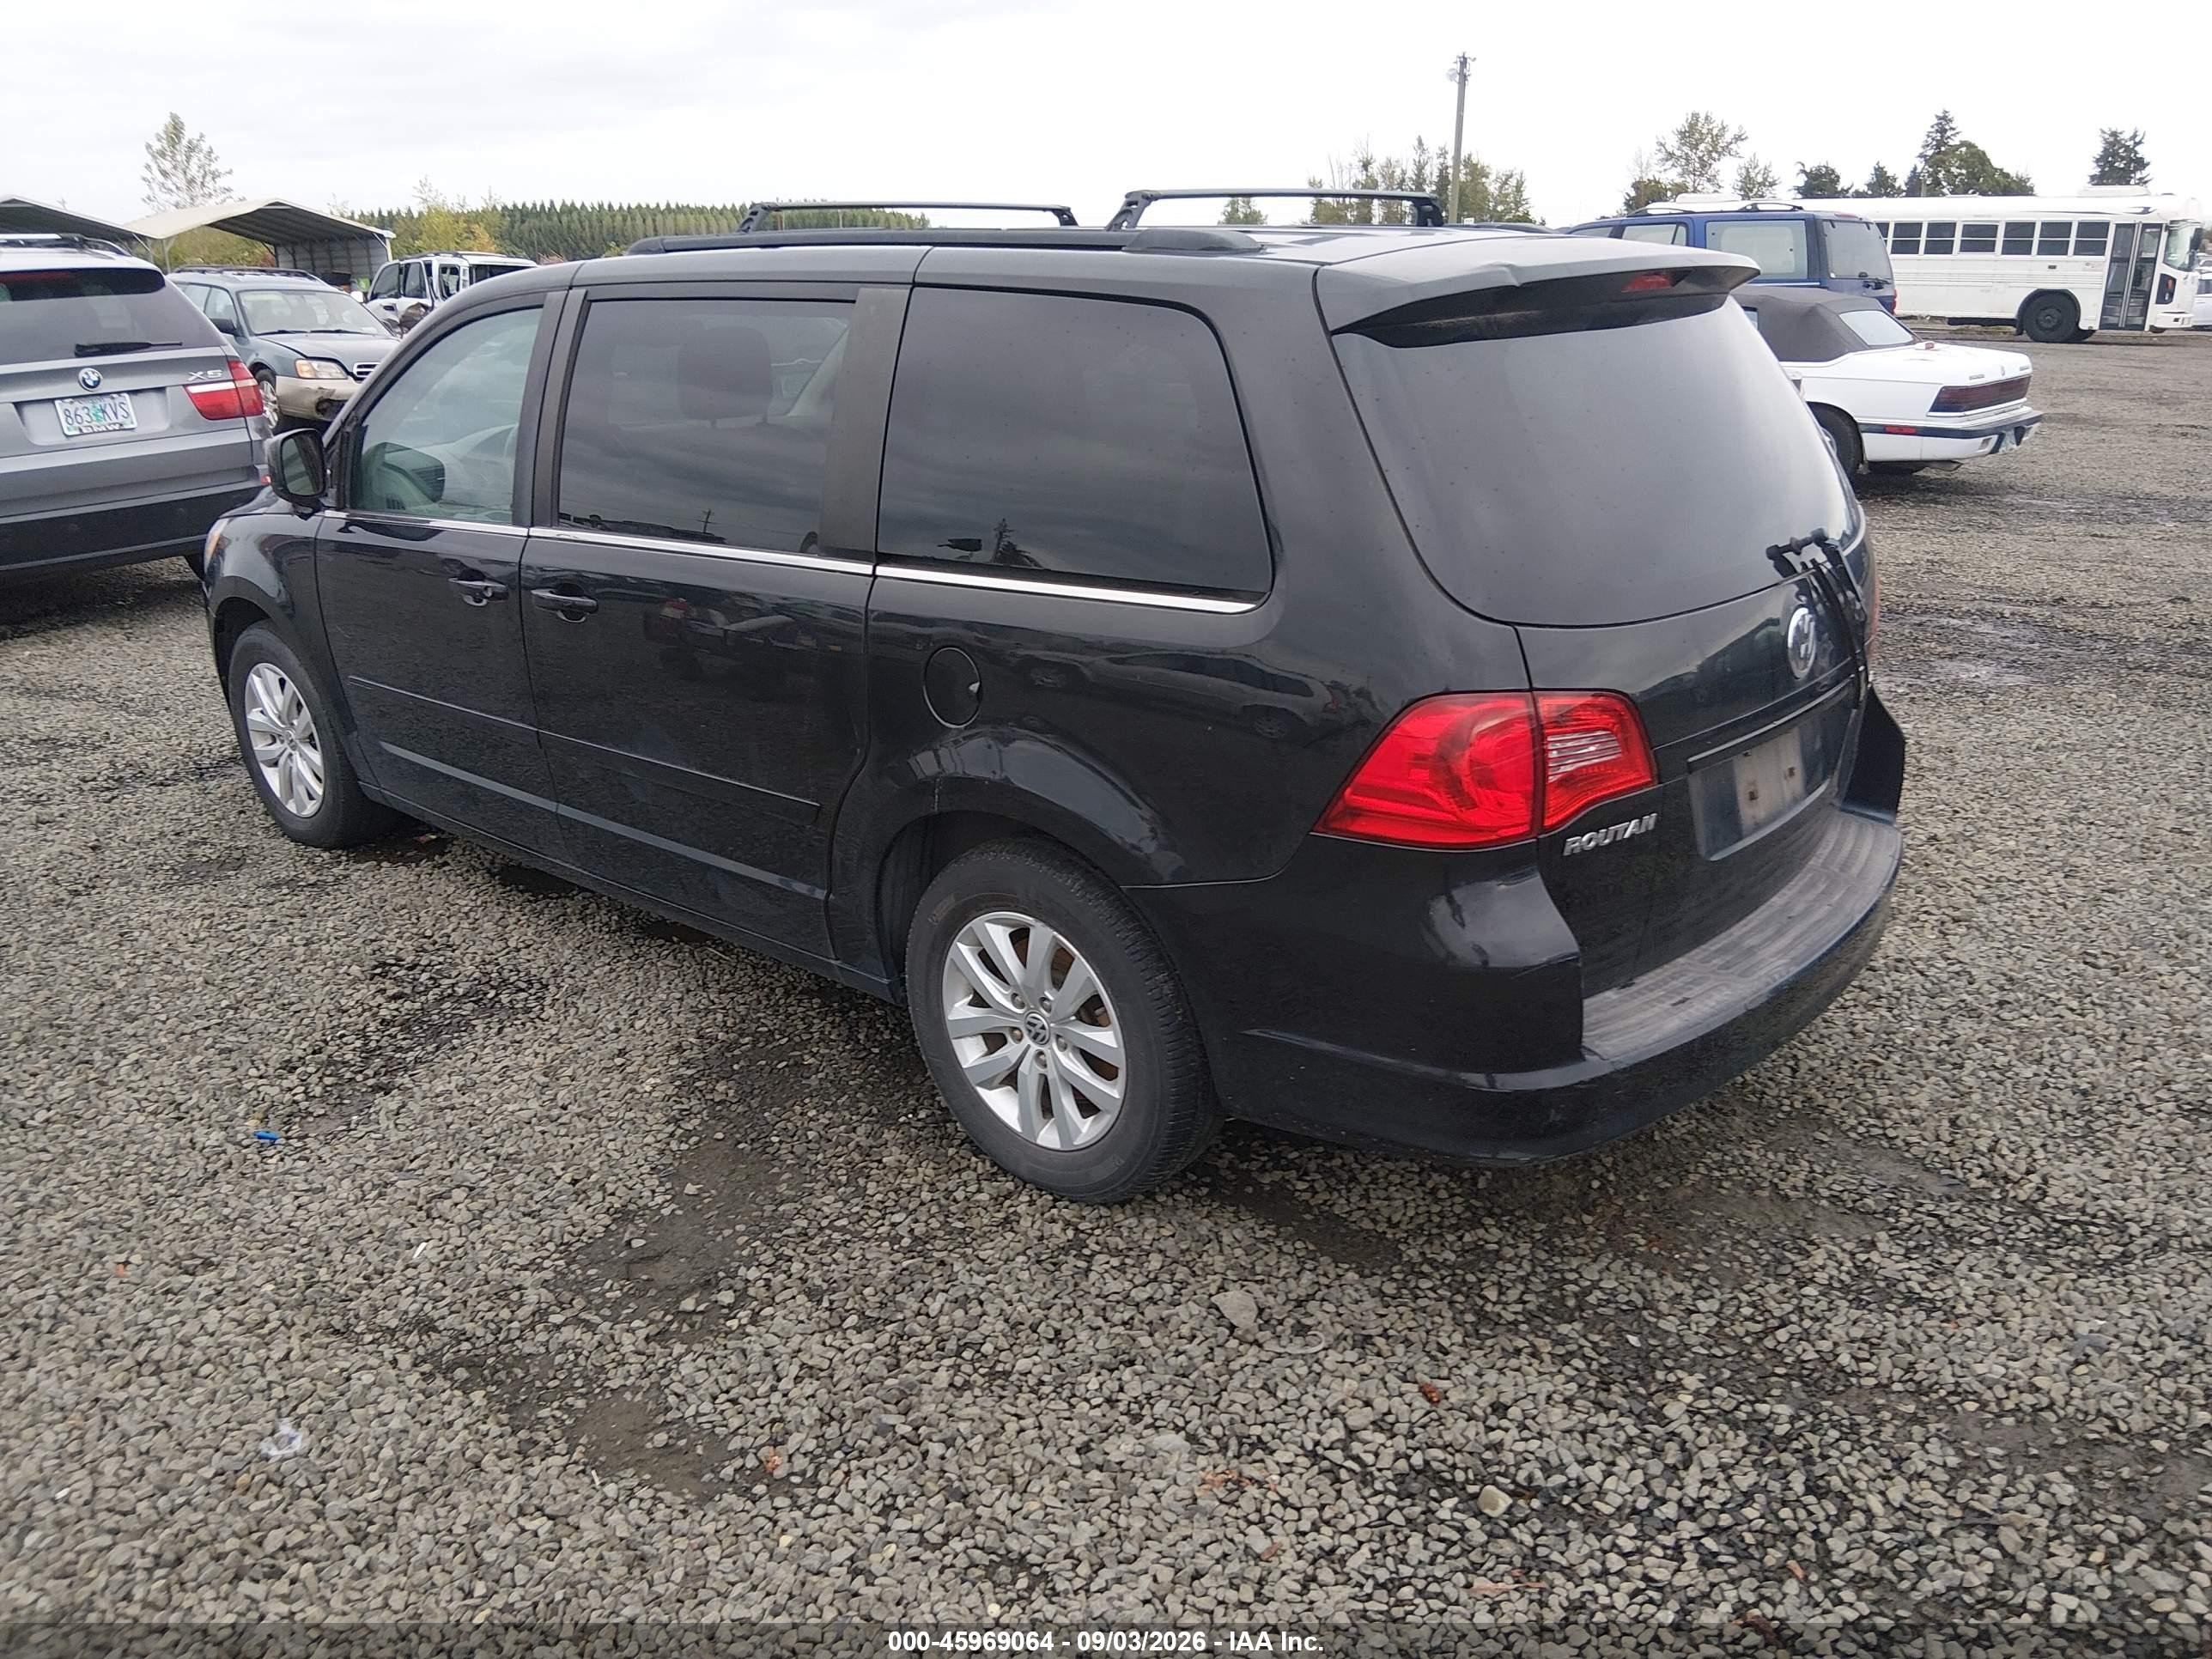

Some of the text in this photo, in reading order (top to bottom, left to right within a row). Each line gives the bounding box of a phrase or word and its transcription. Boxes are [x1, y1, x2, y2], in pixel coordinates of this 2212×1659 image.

[186, 369, 223, 381] X5
[64, 401, 130, 426] 863 KVS
[1563, 812, 1658, 857] ROUTAN
